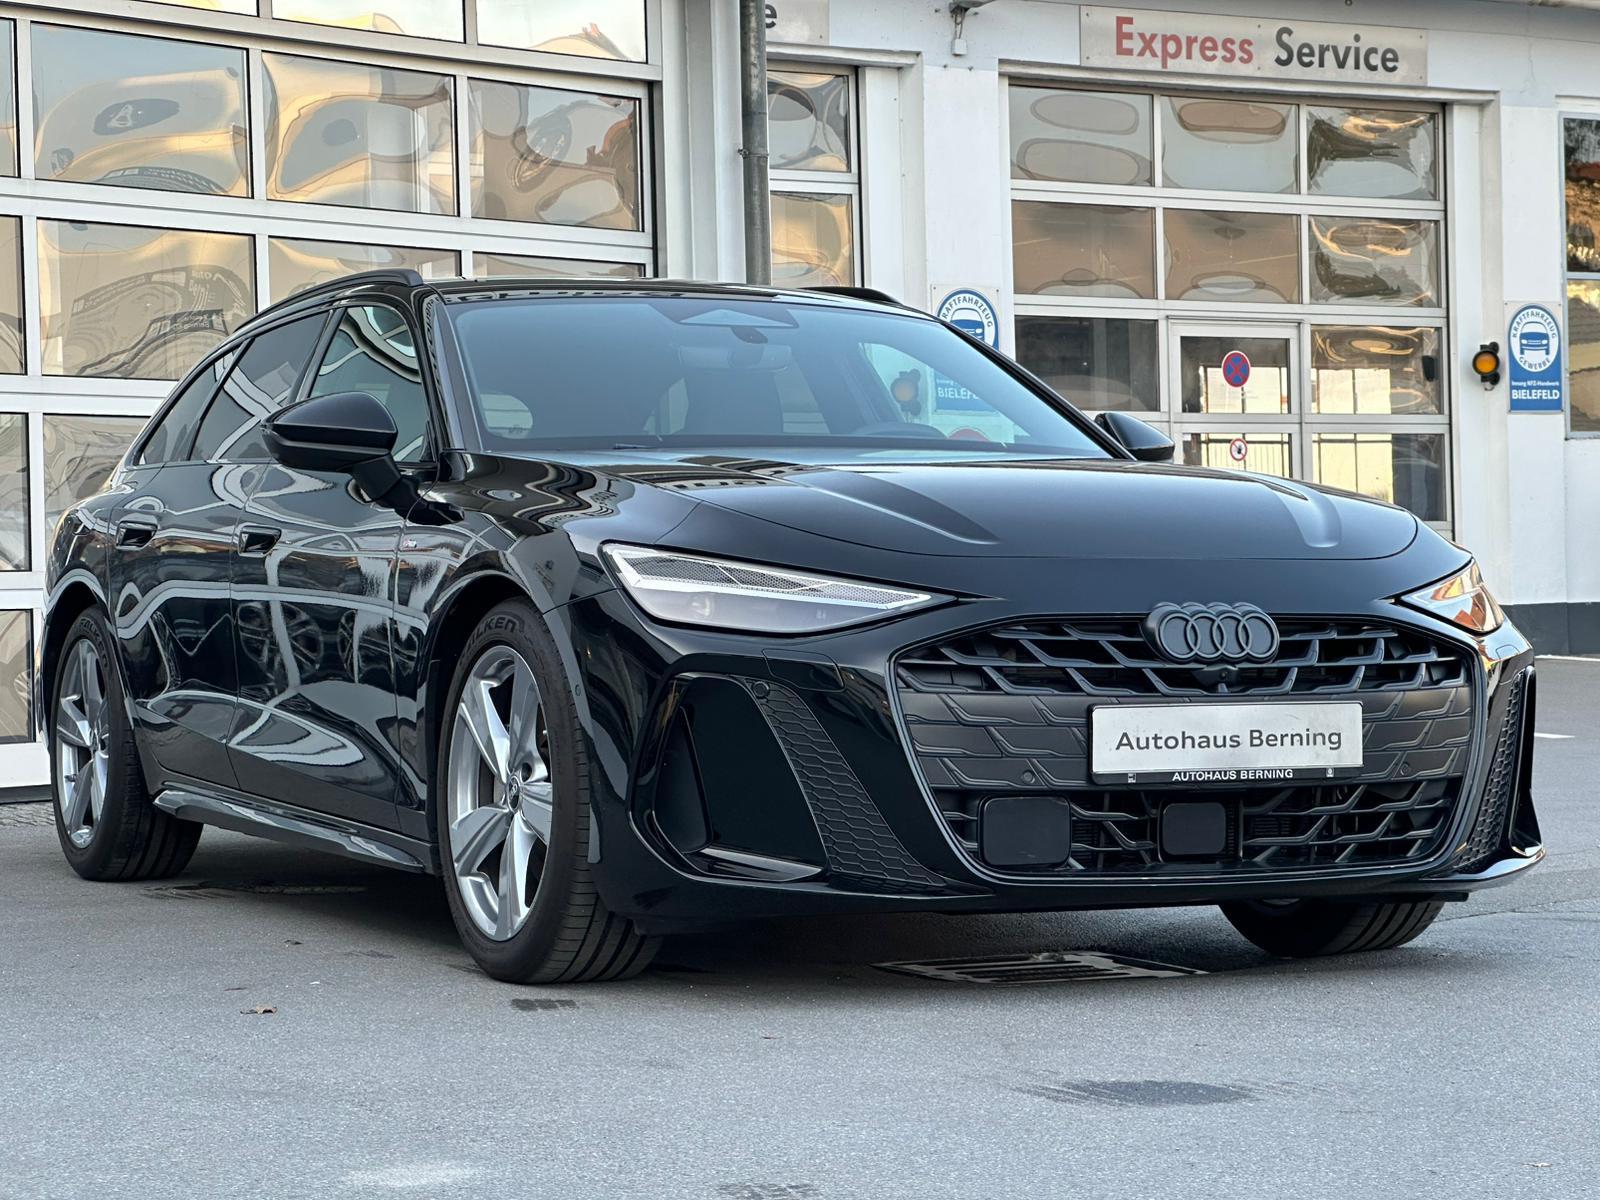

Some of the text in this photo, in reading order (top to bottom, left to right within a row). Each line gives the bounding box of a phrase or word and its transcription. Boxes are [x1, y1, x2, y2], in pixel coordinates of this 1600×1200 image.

[1115, 15, 1400, 73] Express Service
[942, 296, 993, 327] RAFTFAHRZEUG
[1512, 310, 1557, 338] KRAFTFAHRZEUG
[1519, 355, 1551, 371] GEWERBE
[1511, 389, 1560, 400] BIELEFELD
[1115, 728, 1342, 751] Autohaus Berning
[1172, 769, 1294, 782] AUTOHAUS BERNING
